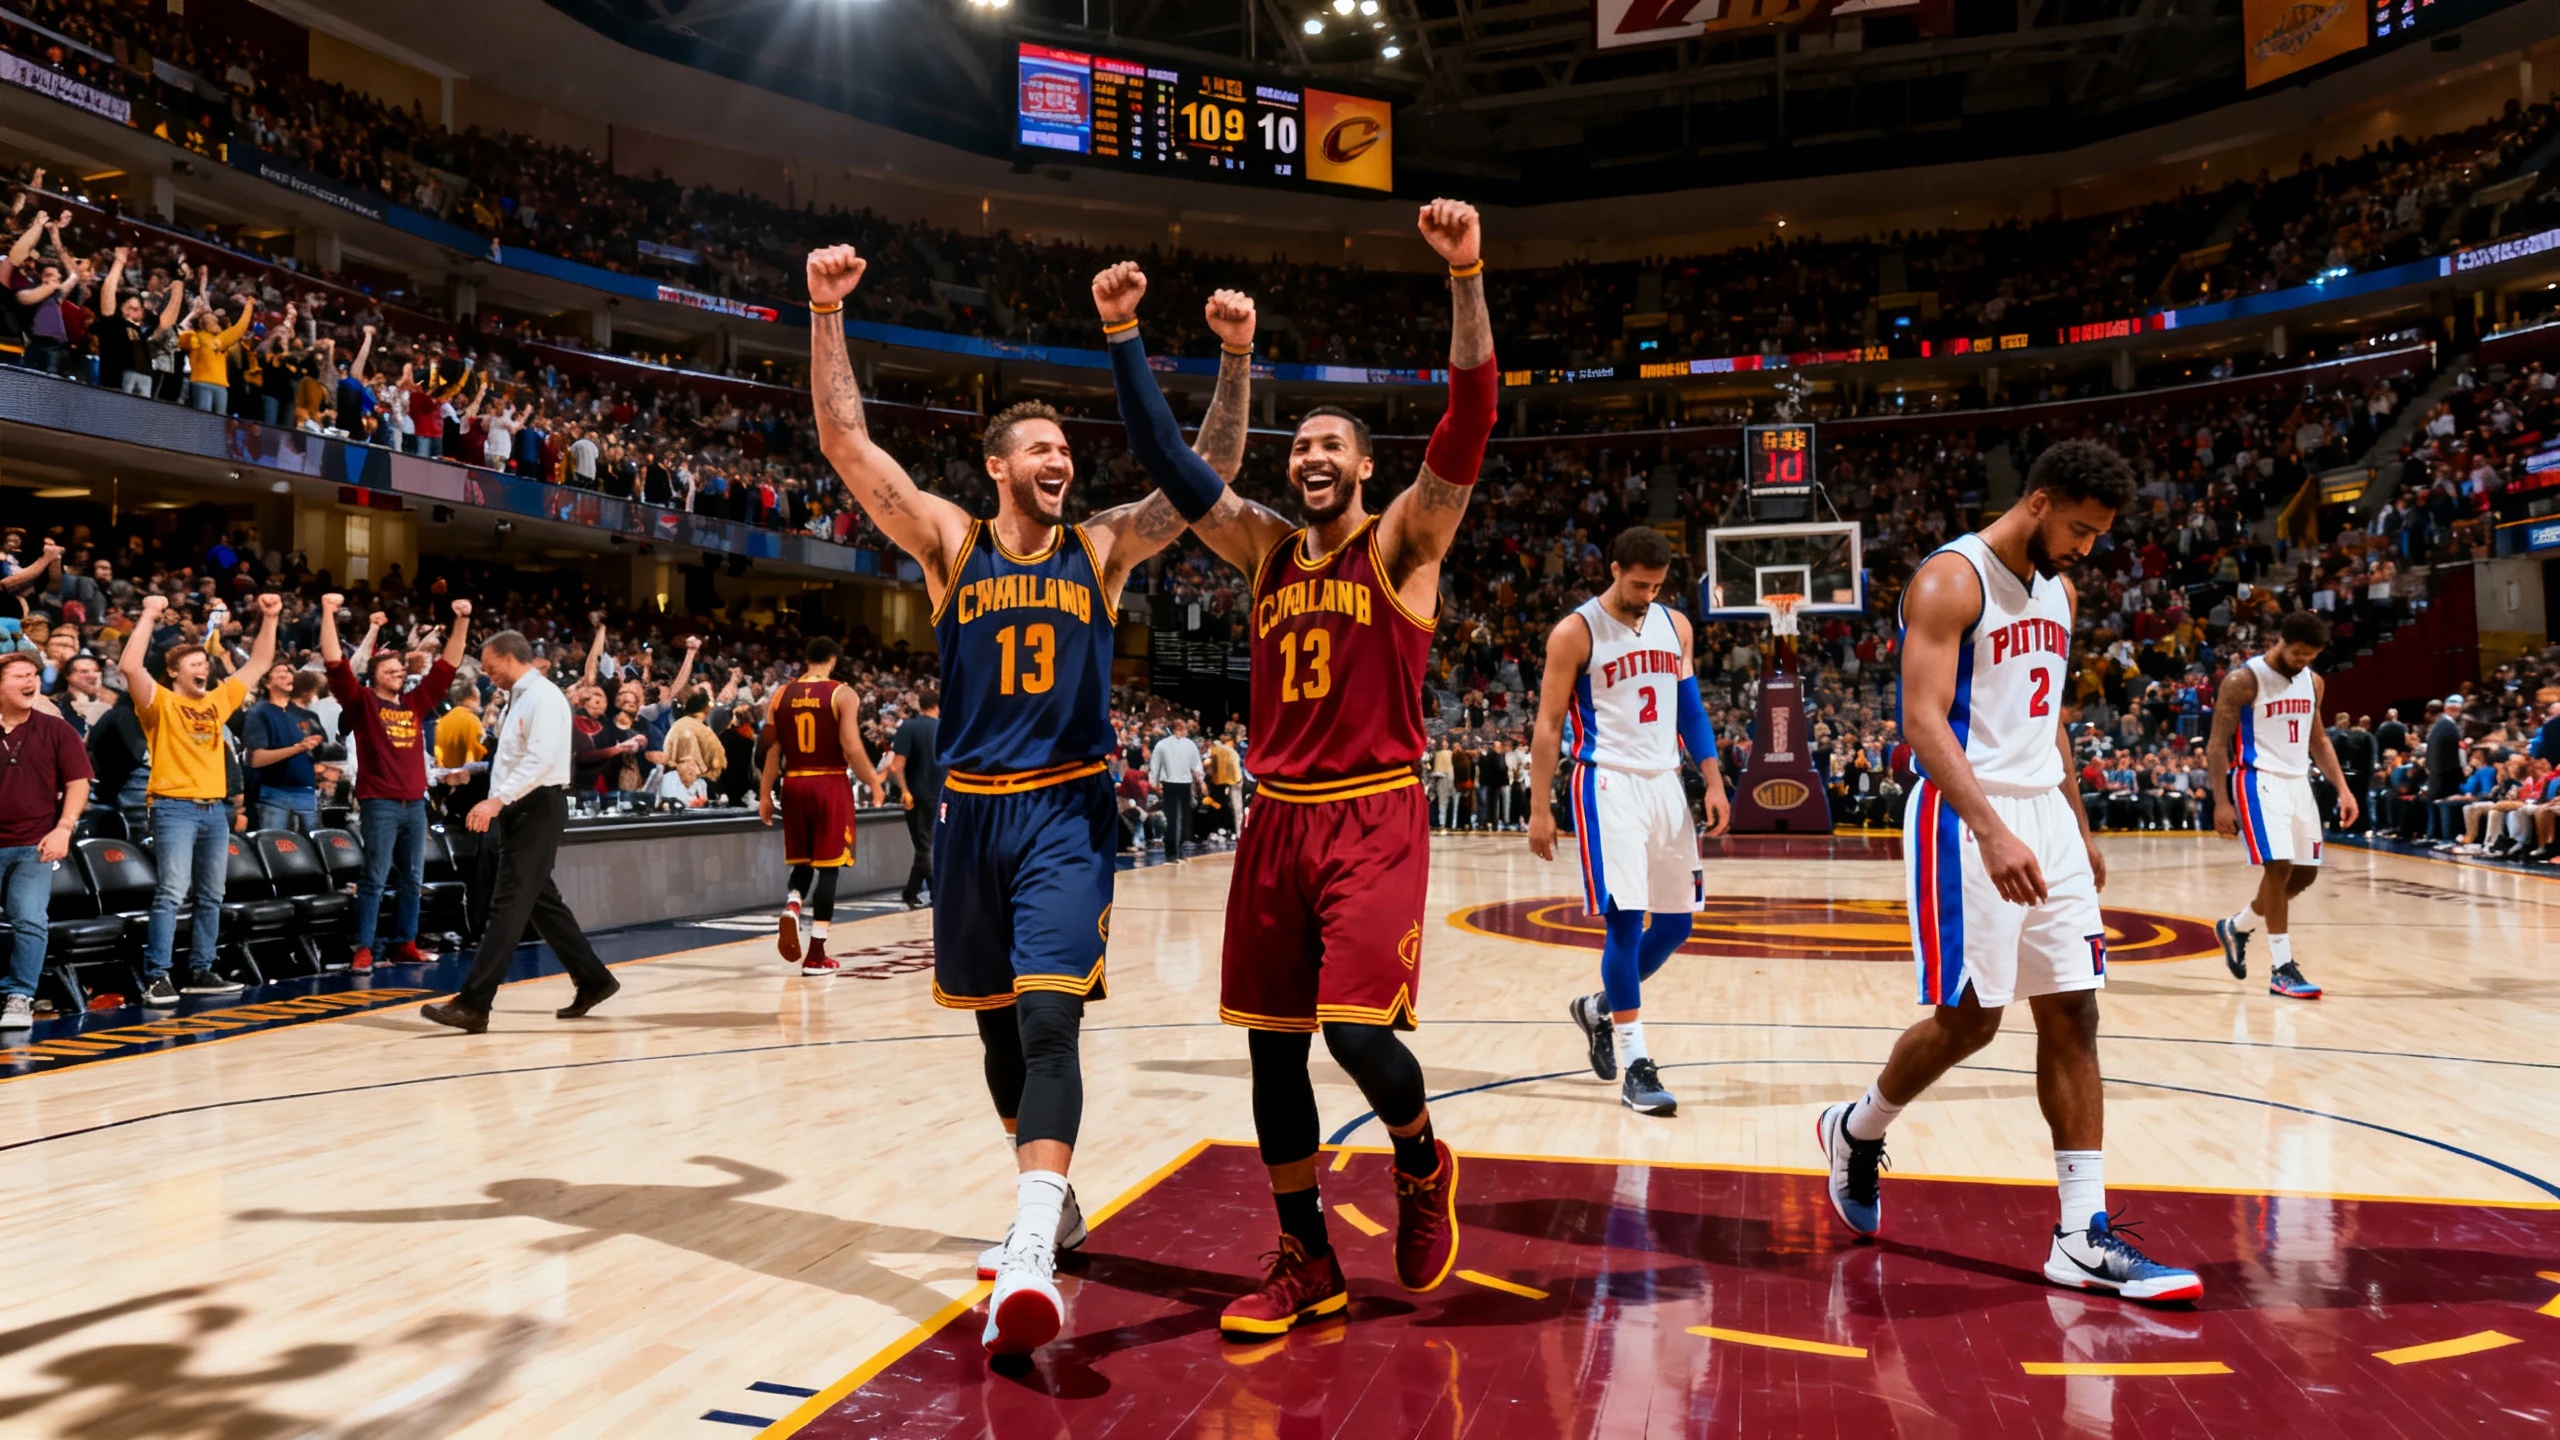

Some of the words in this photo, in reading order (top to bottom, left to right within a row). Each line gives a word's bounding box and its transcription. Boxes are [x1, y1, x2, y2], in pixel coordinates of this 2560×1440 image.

[1181, 102, 1245, 141] 109
[1258, 112, 1297, 154] 10
[996, 622, 1055, 695] 13
[1638, 686, 1657, 724] 2
[2030, 667, 2050, 718] 2
